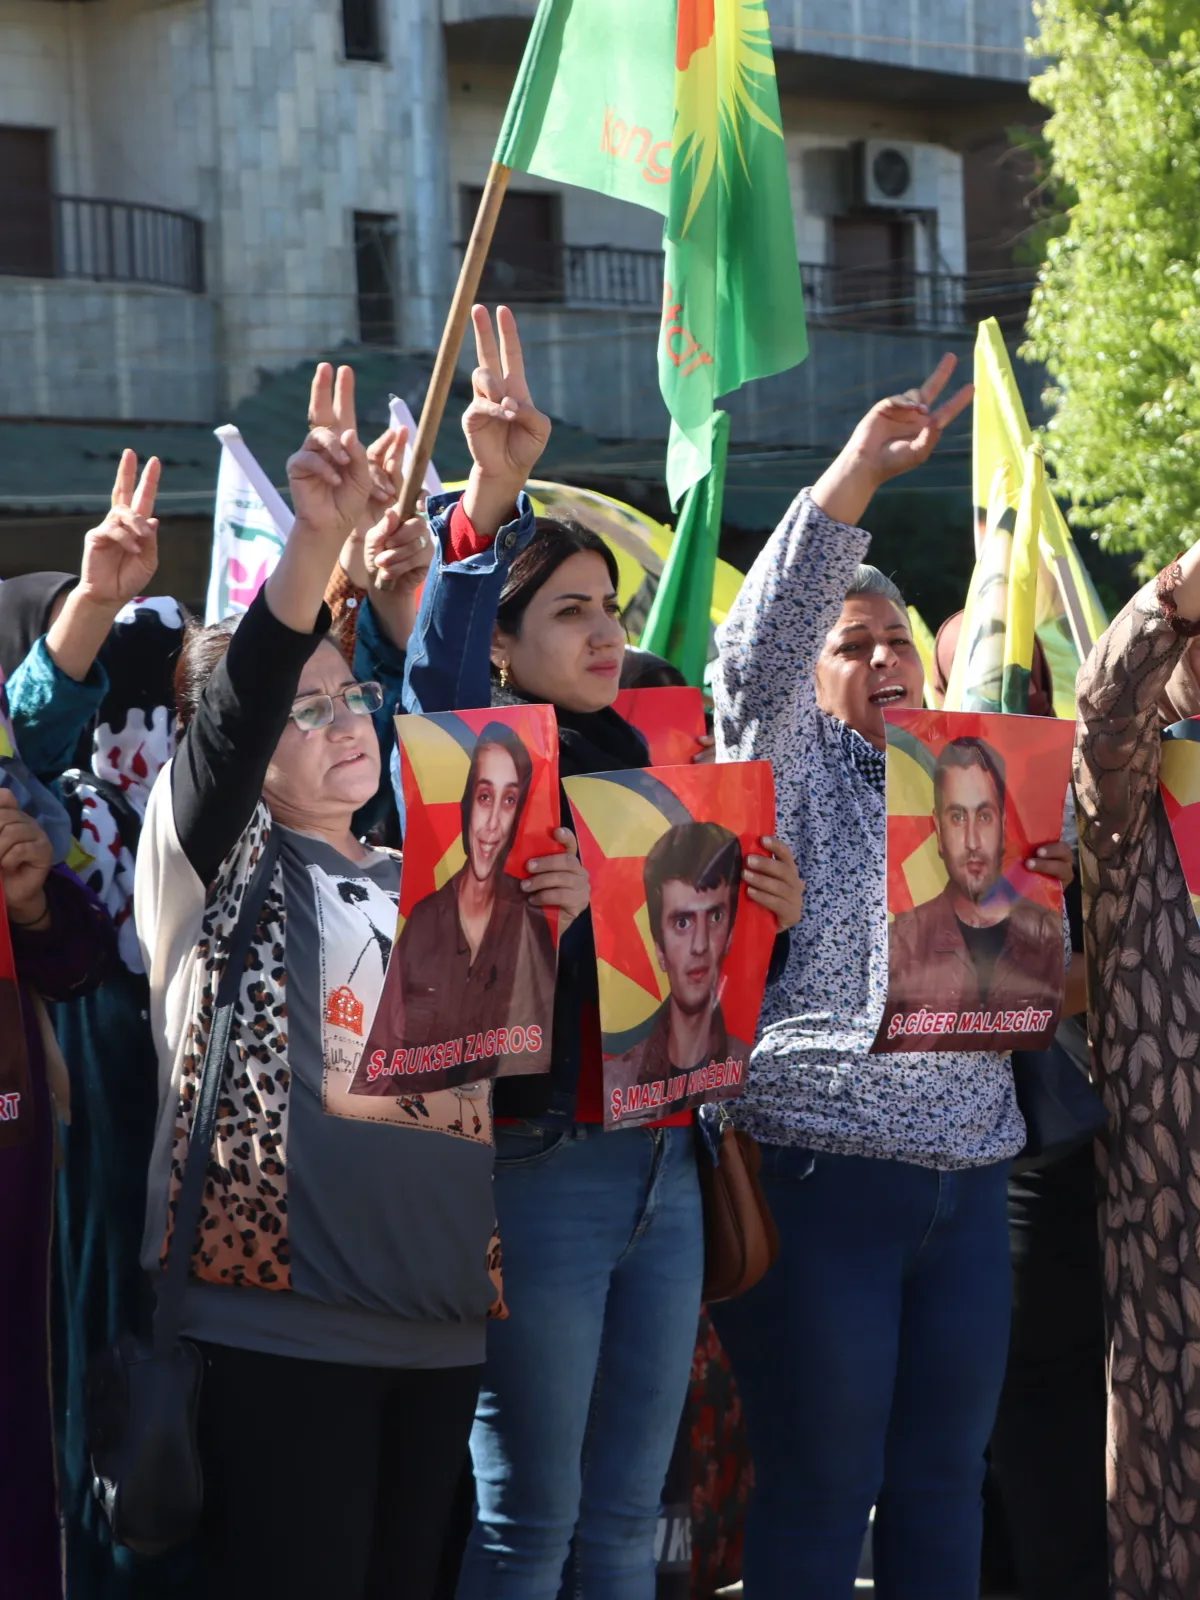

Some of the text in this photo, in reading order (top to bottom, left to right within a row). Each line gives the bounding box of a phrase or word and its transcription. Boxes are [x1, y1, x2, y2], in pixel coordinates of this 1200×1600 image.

[887, 1006, 1052, 1039] Ş.CÎGER MALAZGÎRT
[366, 1037, 463, 1082] Ş.RUKSEN
[463, 1024, 542, 1063] ZAGROS
